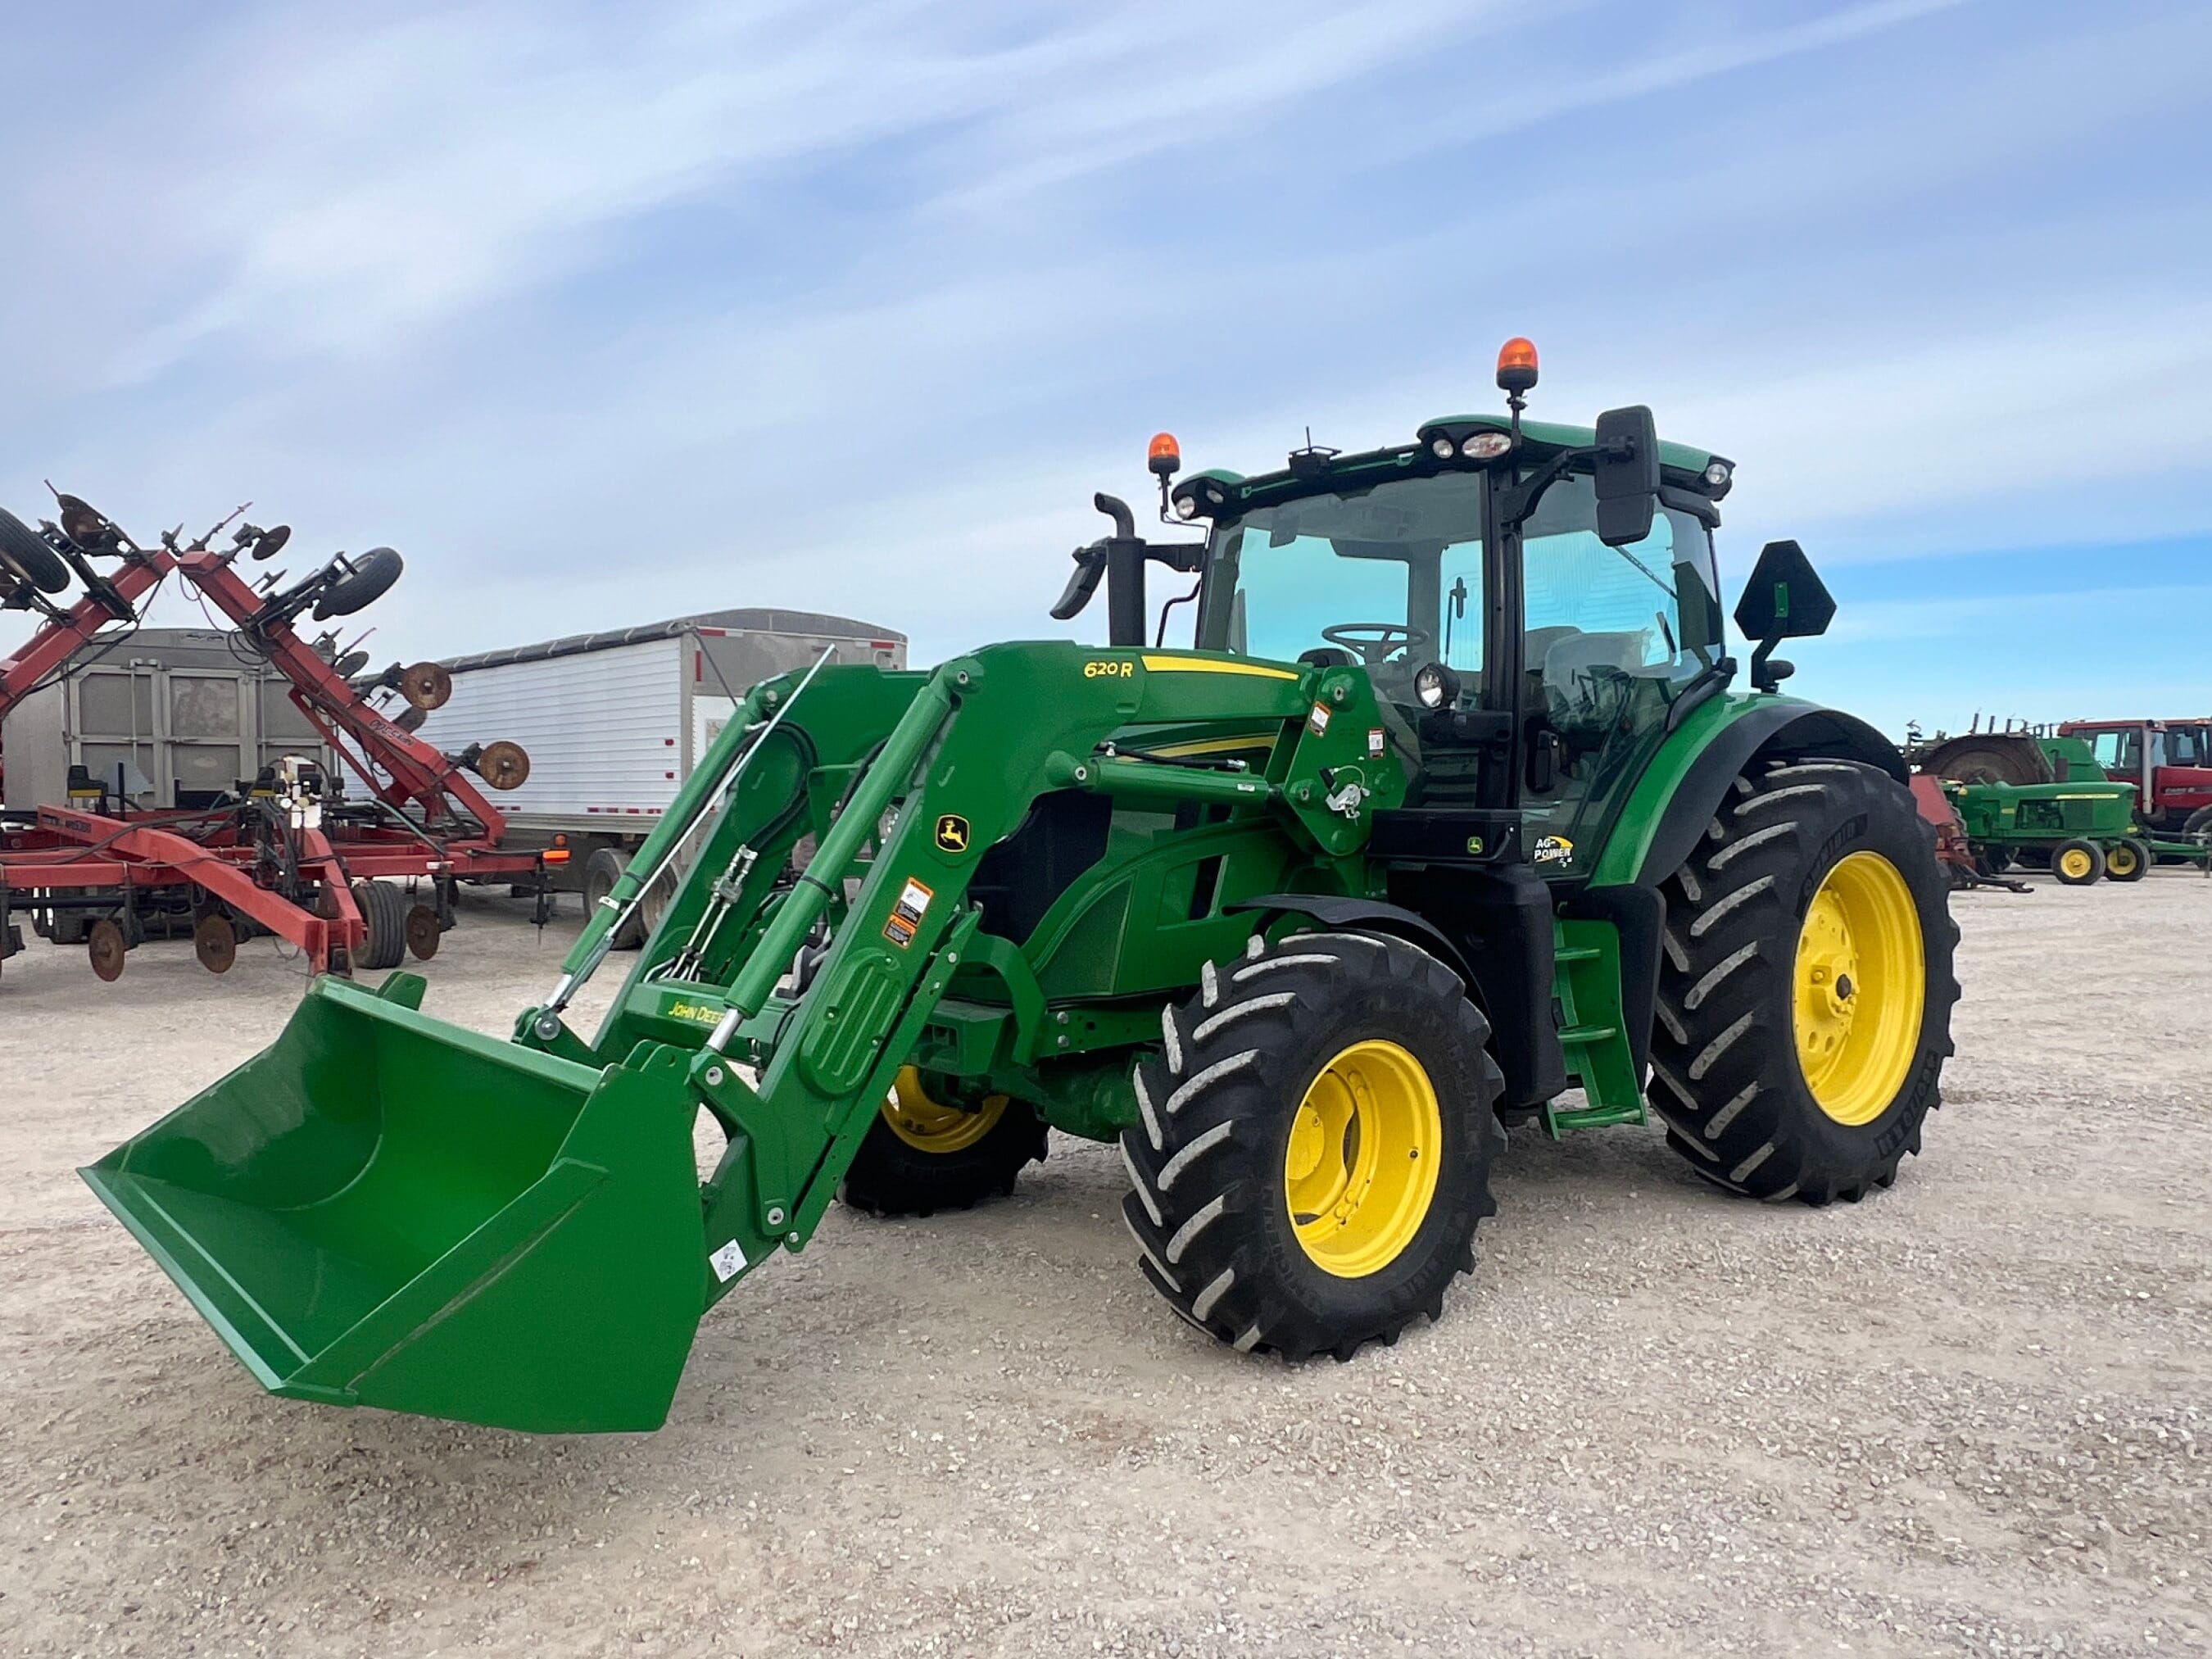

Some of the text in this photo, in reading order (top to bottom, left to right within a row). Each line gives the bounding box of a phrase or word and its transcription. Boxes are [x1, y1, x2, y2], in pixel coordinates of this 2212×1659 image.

[1534, 838, 1557, 849] AG-
[1534, 847, 1571, 859] POWER
[668, 1000, 727, 1024] JOHN DEER
